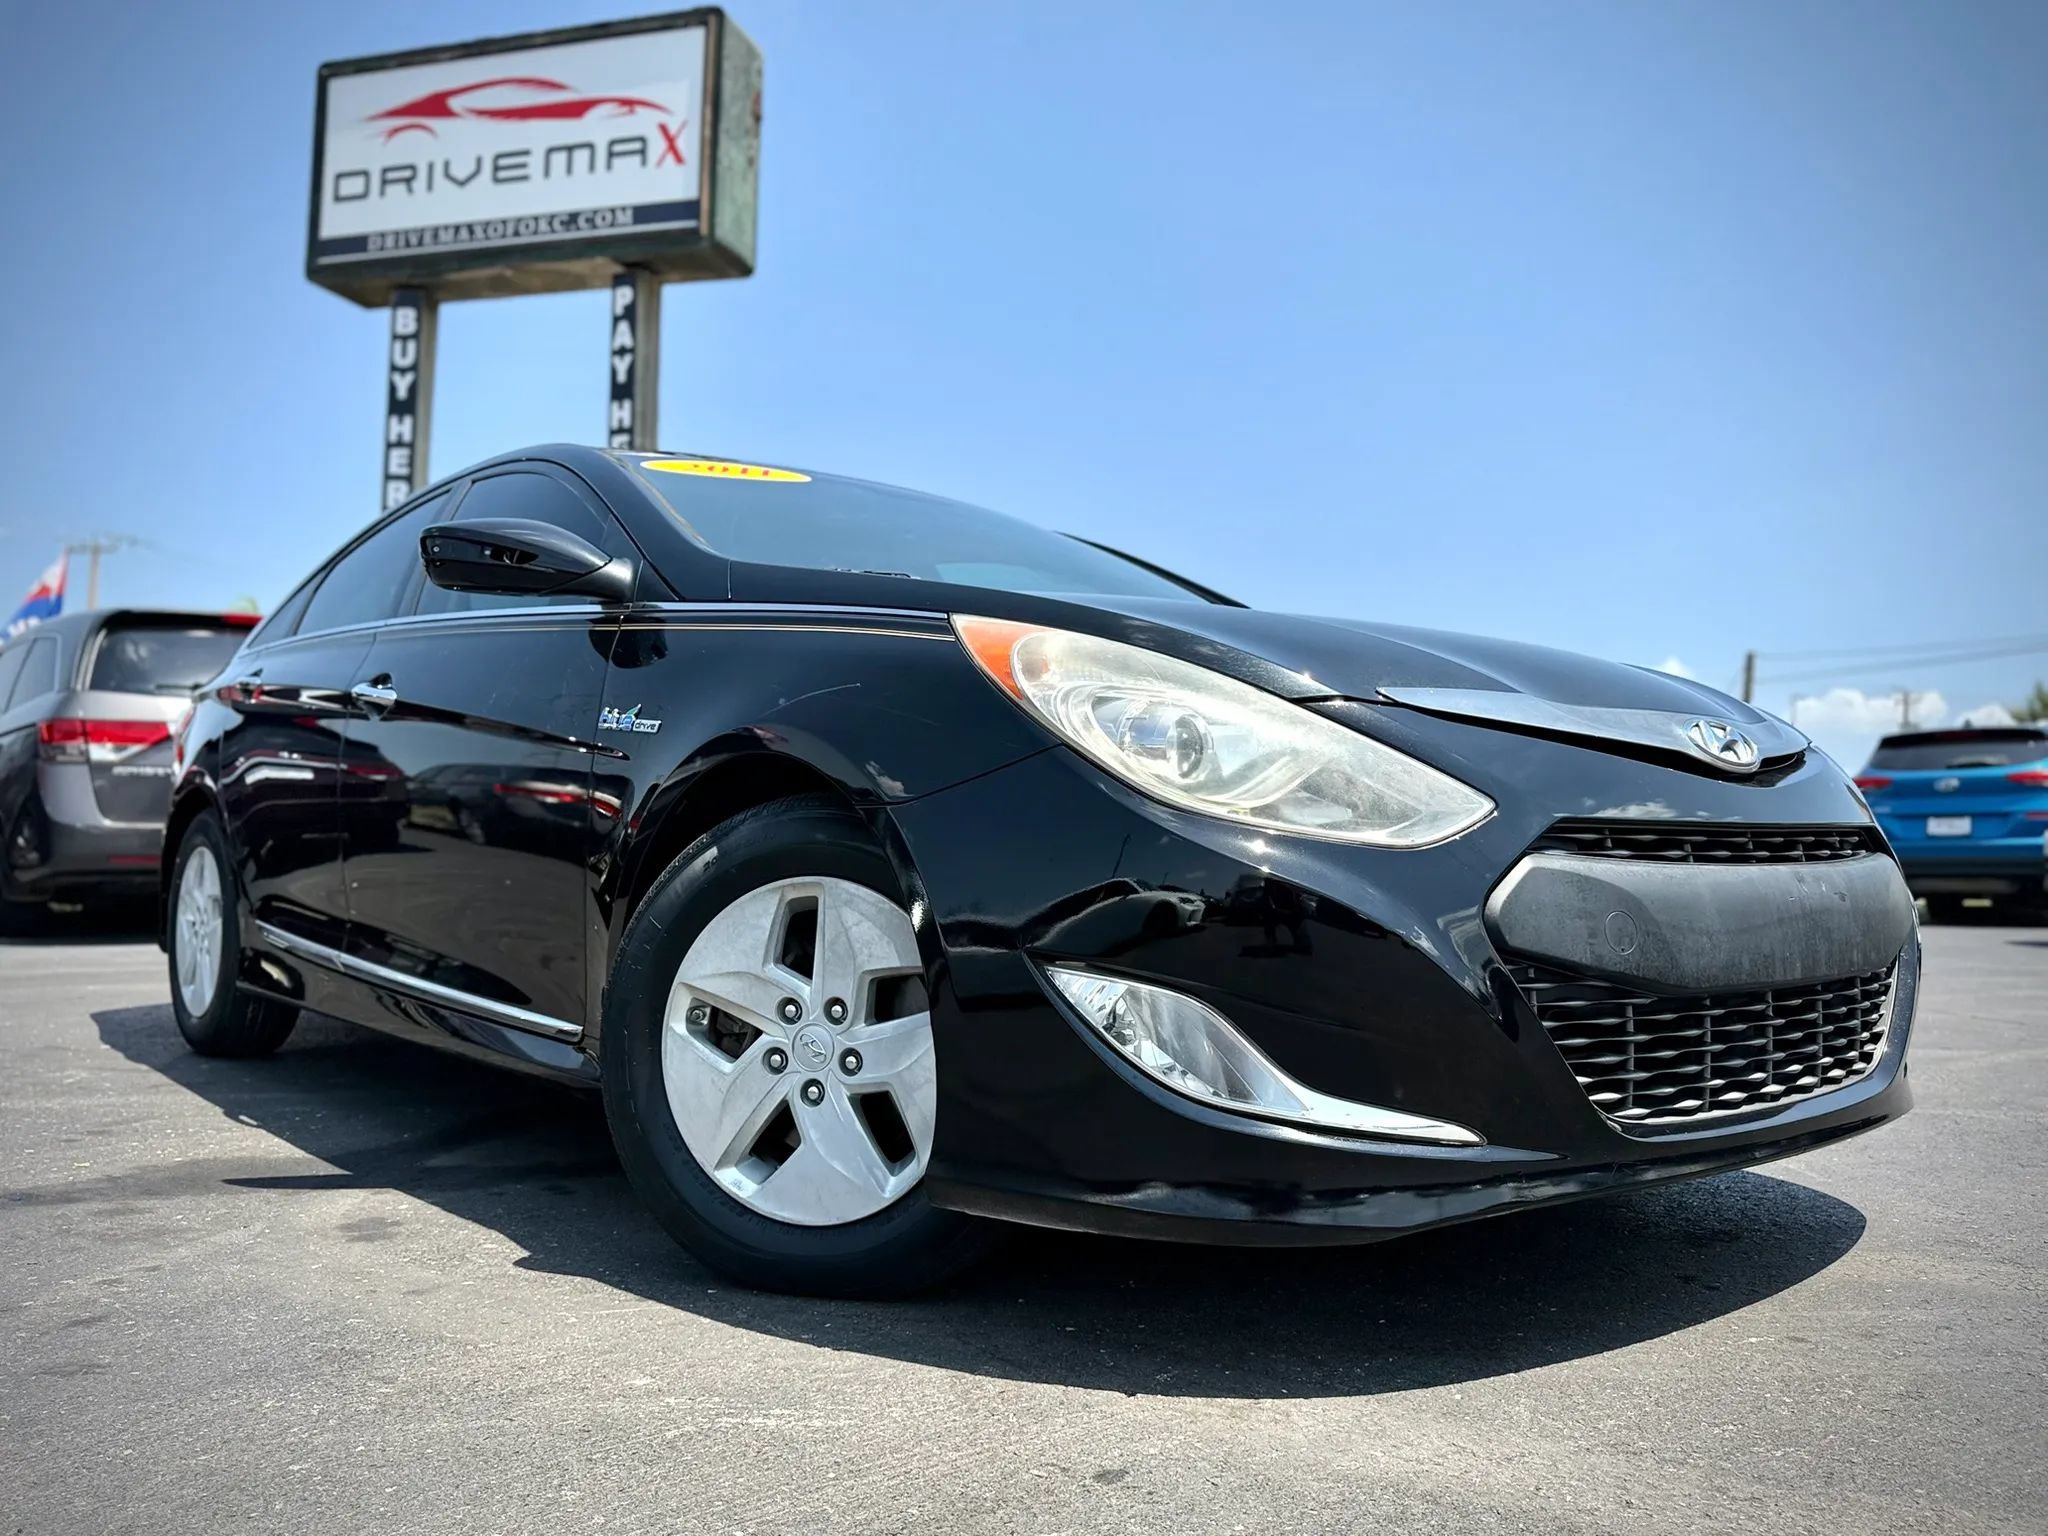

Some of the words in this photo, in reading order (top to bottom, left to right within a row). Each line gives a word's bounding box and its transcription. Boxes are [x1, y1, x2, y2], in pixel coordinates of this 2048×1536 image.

[332, 120, 688, 203] DRIVEMAX
[367, 207, 634, 252] DRIVEMAXOFOKC.COM
[390, 306, 419, 401] BUY
[612, 284, 635, 385] PAY
